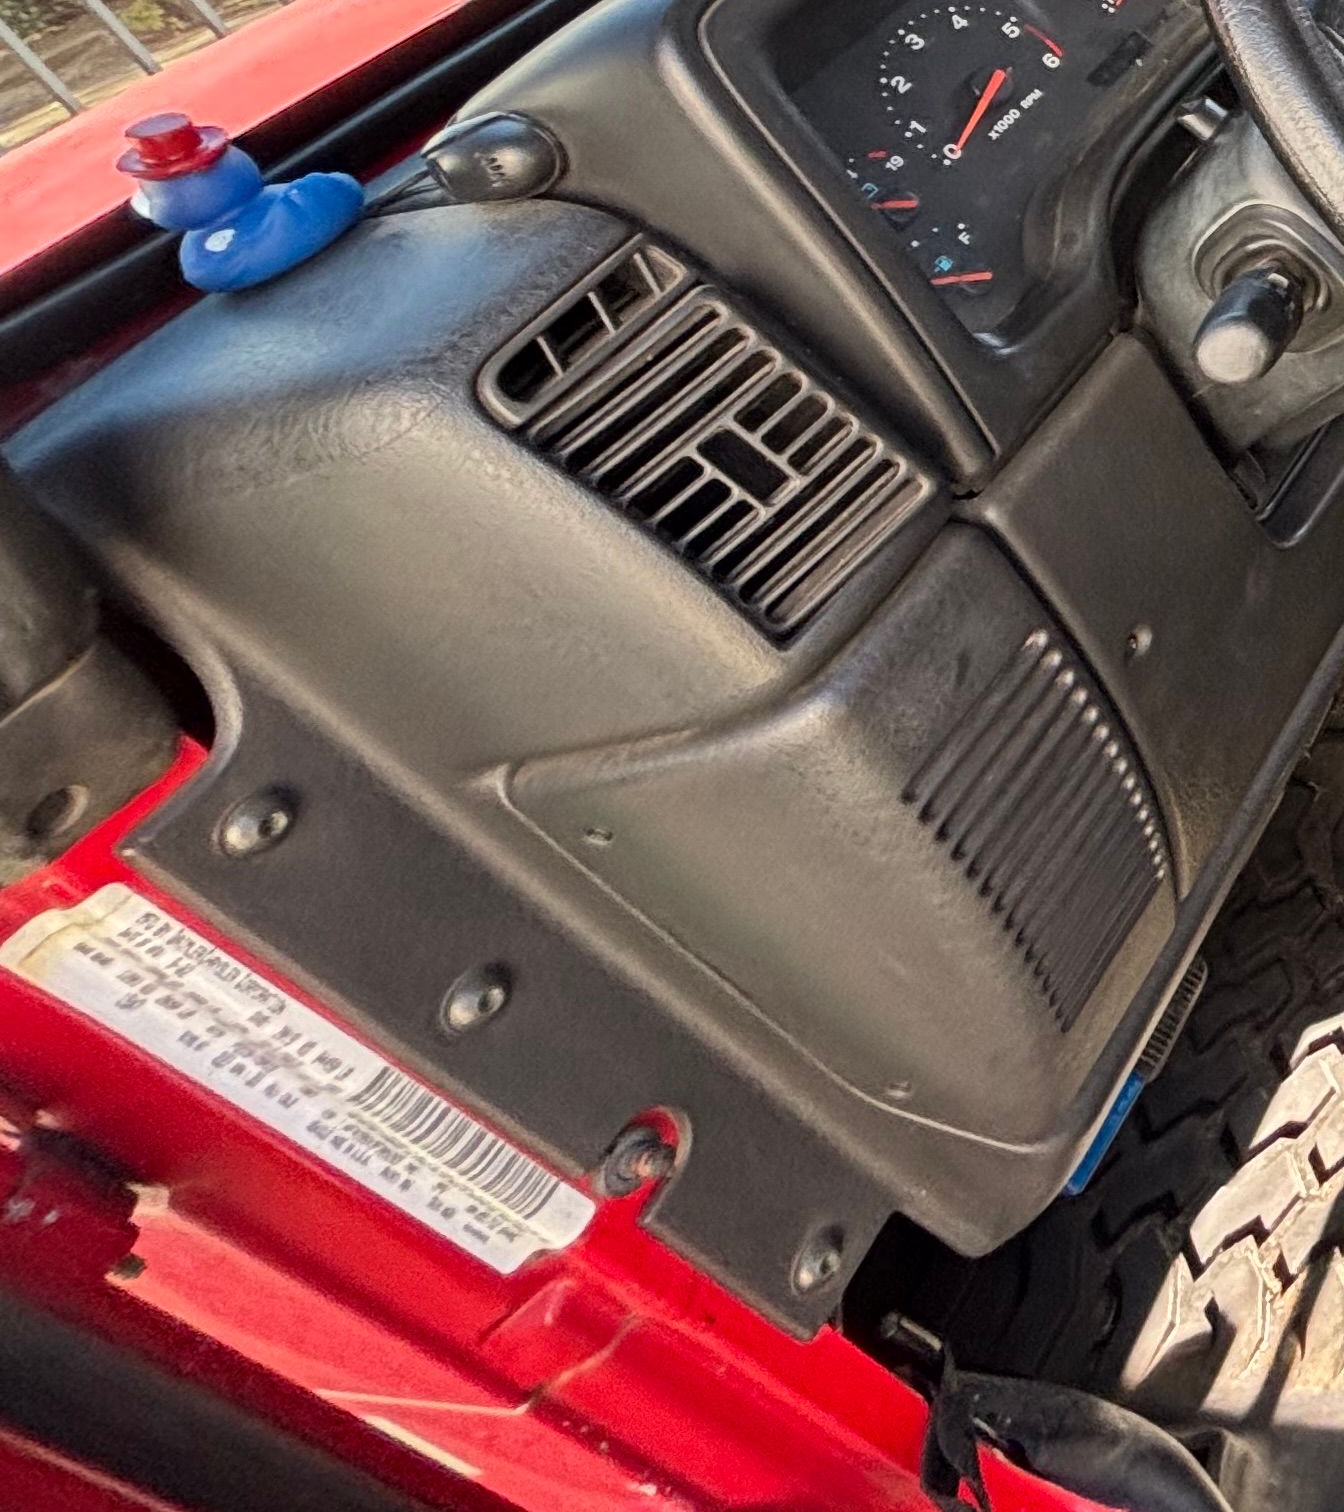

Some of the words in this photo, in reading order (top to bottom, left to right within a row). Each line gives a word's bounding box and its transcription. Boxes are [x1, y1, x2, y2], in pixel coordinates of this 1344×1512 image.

[952, 15, 968, 30] 4
[1001, 22, 1021, 38] 5
[905, 34, 925, 50] 3
[1042, 53, 1061, 68] 6
[890, 76, 913, 94] 2
[1020, 89, 1044, 109] RPM
[909, 121, 927, 133] 1
[943, 143, 962, 160] 0
[885, 156, 904, 171] 19
[958, 231, 970, 245] F
